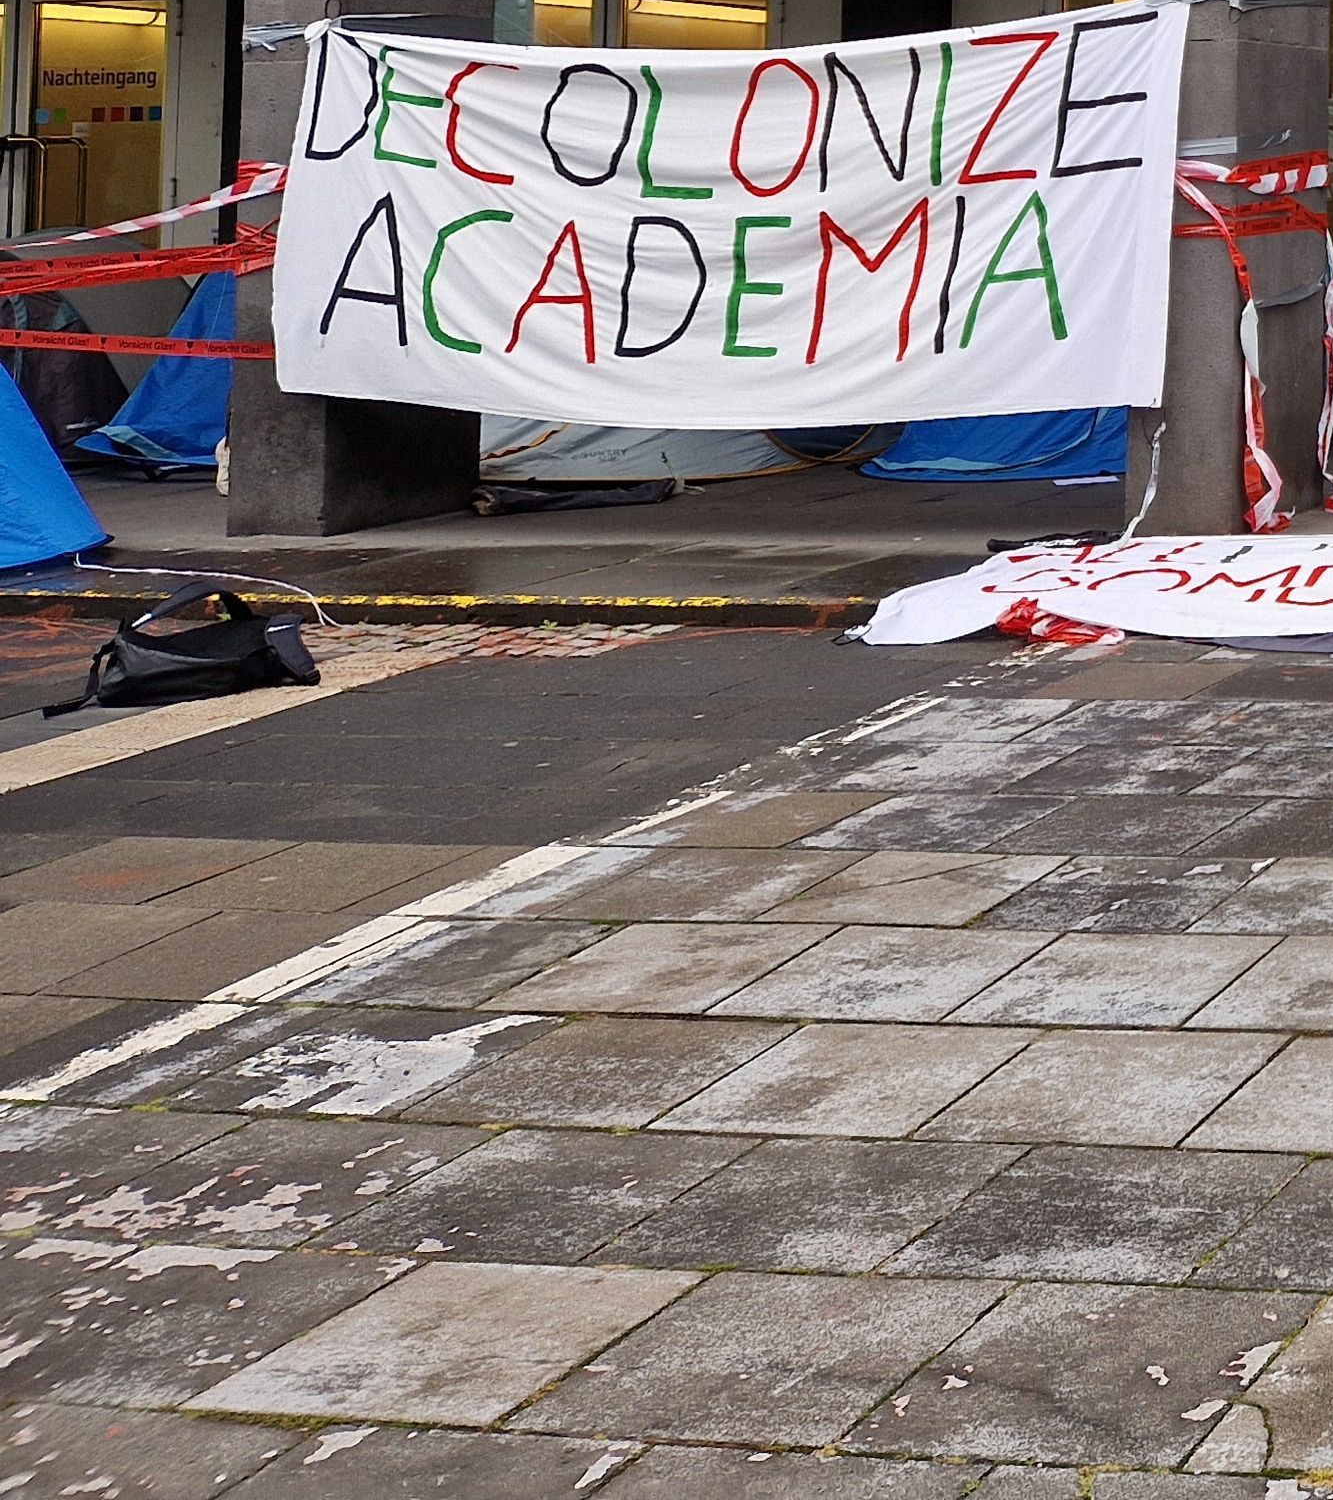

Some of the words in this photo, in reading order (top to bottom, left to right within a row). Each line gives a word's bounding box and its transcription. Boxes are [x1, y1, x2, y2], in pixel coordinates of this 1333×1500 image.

[43, 68, 157, 89] Nachteingang
[304, 11, 1159, 199] DECOLONIZE
[319, 190, 1068, 365] ACADEMIA
